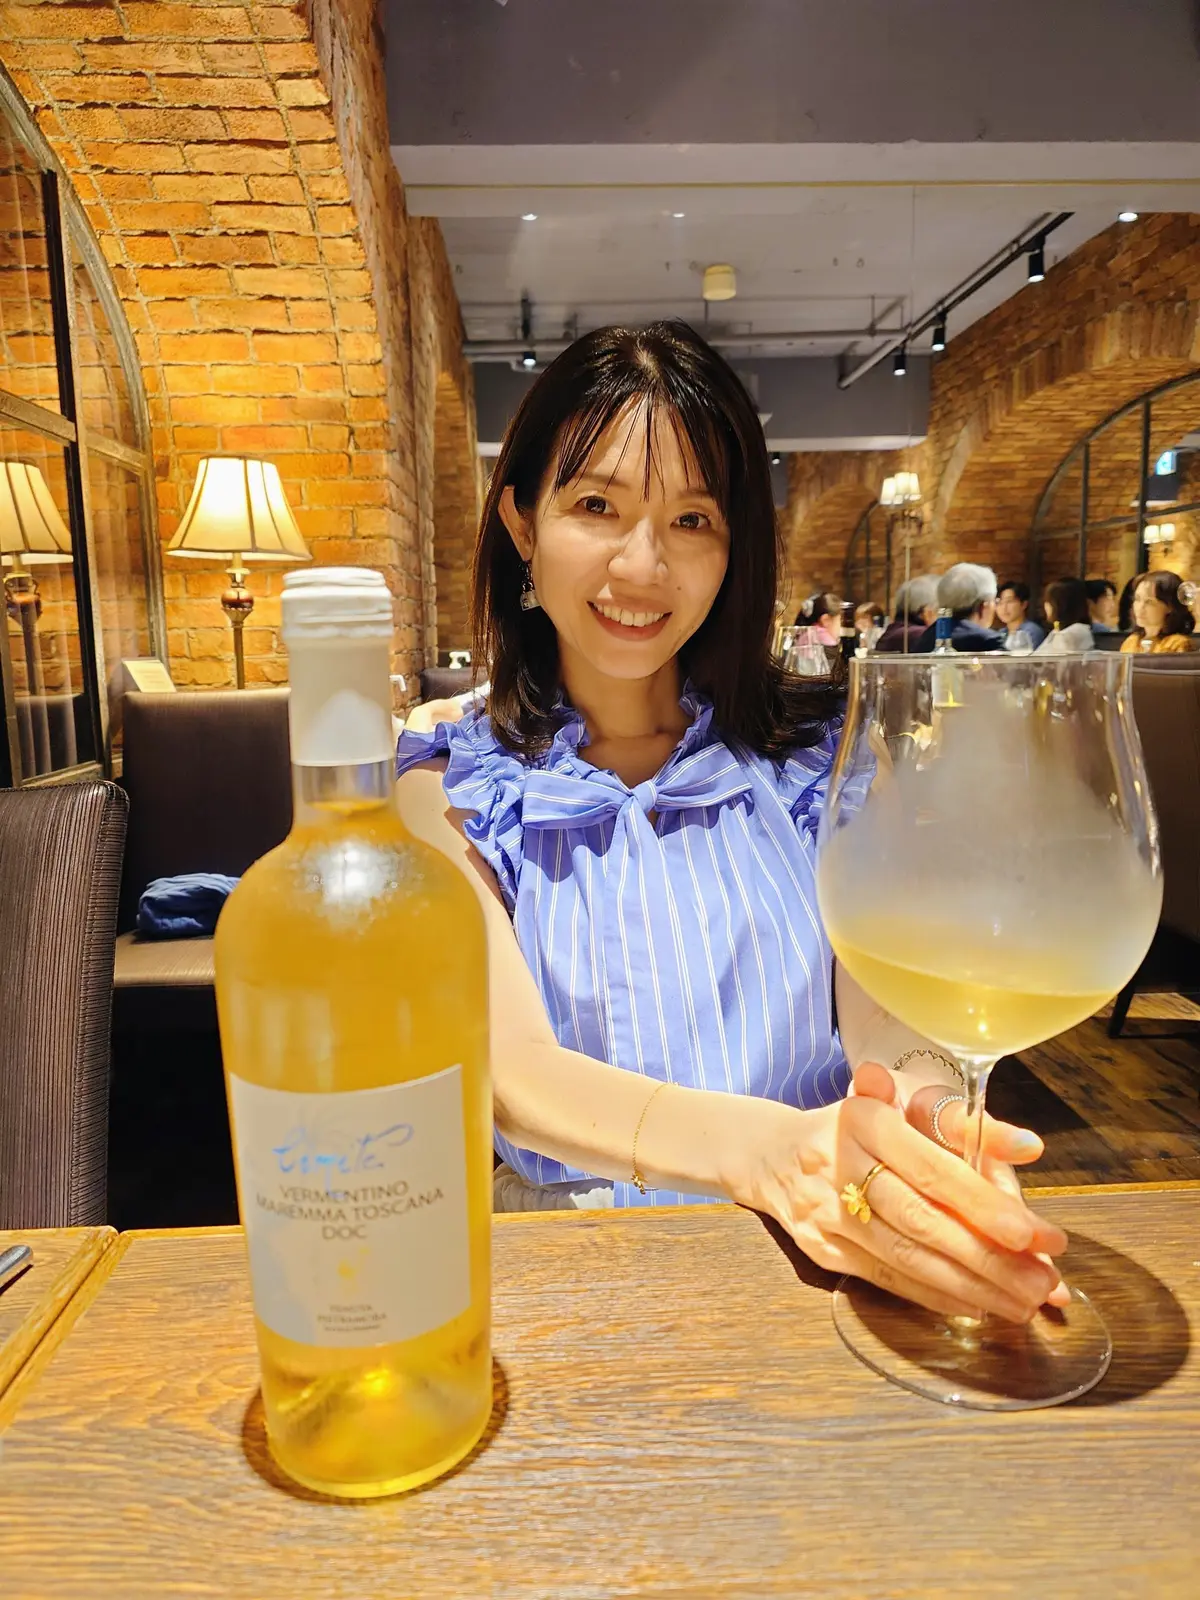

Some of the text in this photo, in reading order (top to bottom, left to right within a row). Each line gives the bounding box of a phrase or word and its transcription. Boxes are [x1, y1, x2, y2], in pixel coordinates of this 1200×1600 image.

[255, 1187, 445, 1222] MAREMMA TOSCANA
[279, 1180, 411, 1205] VERMENTINO
[321, 1225, 369, 1241] DOC
